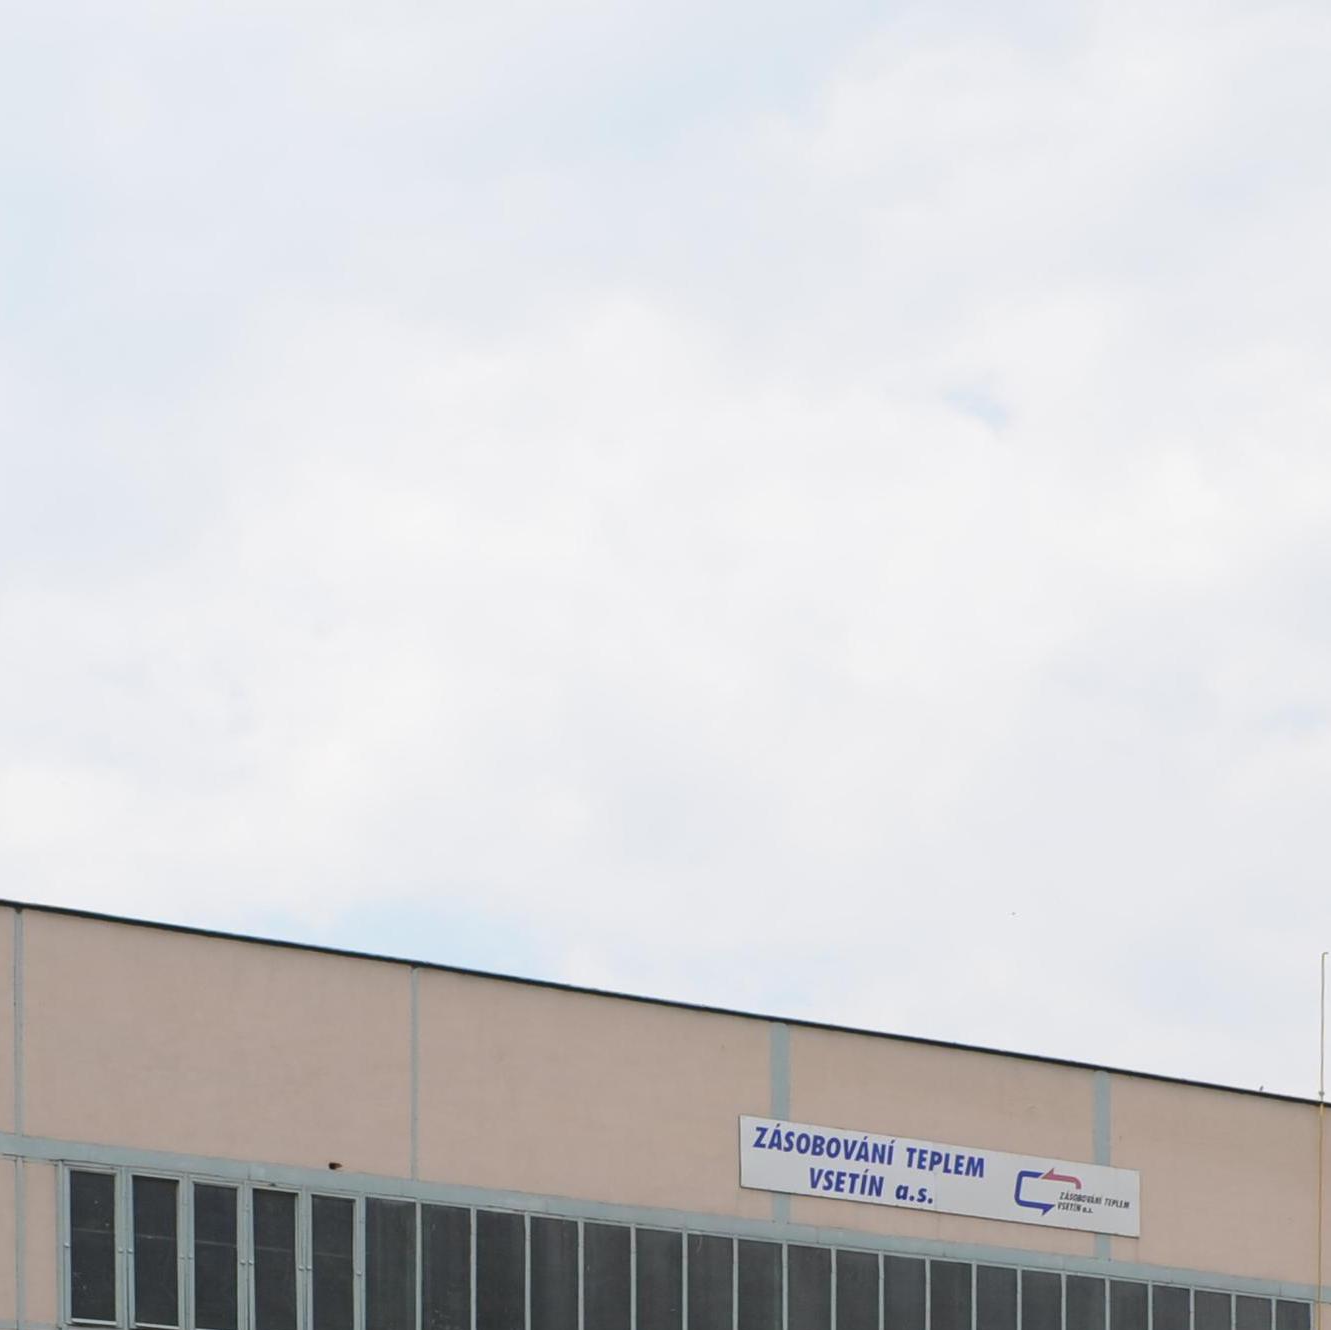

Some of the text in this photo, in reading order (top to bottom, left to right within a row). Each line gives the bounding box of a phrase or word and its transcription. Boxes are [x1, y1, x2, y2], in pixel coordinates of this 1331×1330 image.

[752, 1123, 985, 1178] ZÁSOBOVÁNÍ TEPLEM
[809, 1167, 933, 1204] VSETÍN a.s.
[1104, 1198, 1130, 1208] TEPLEM
